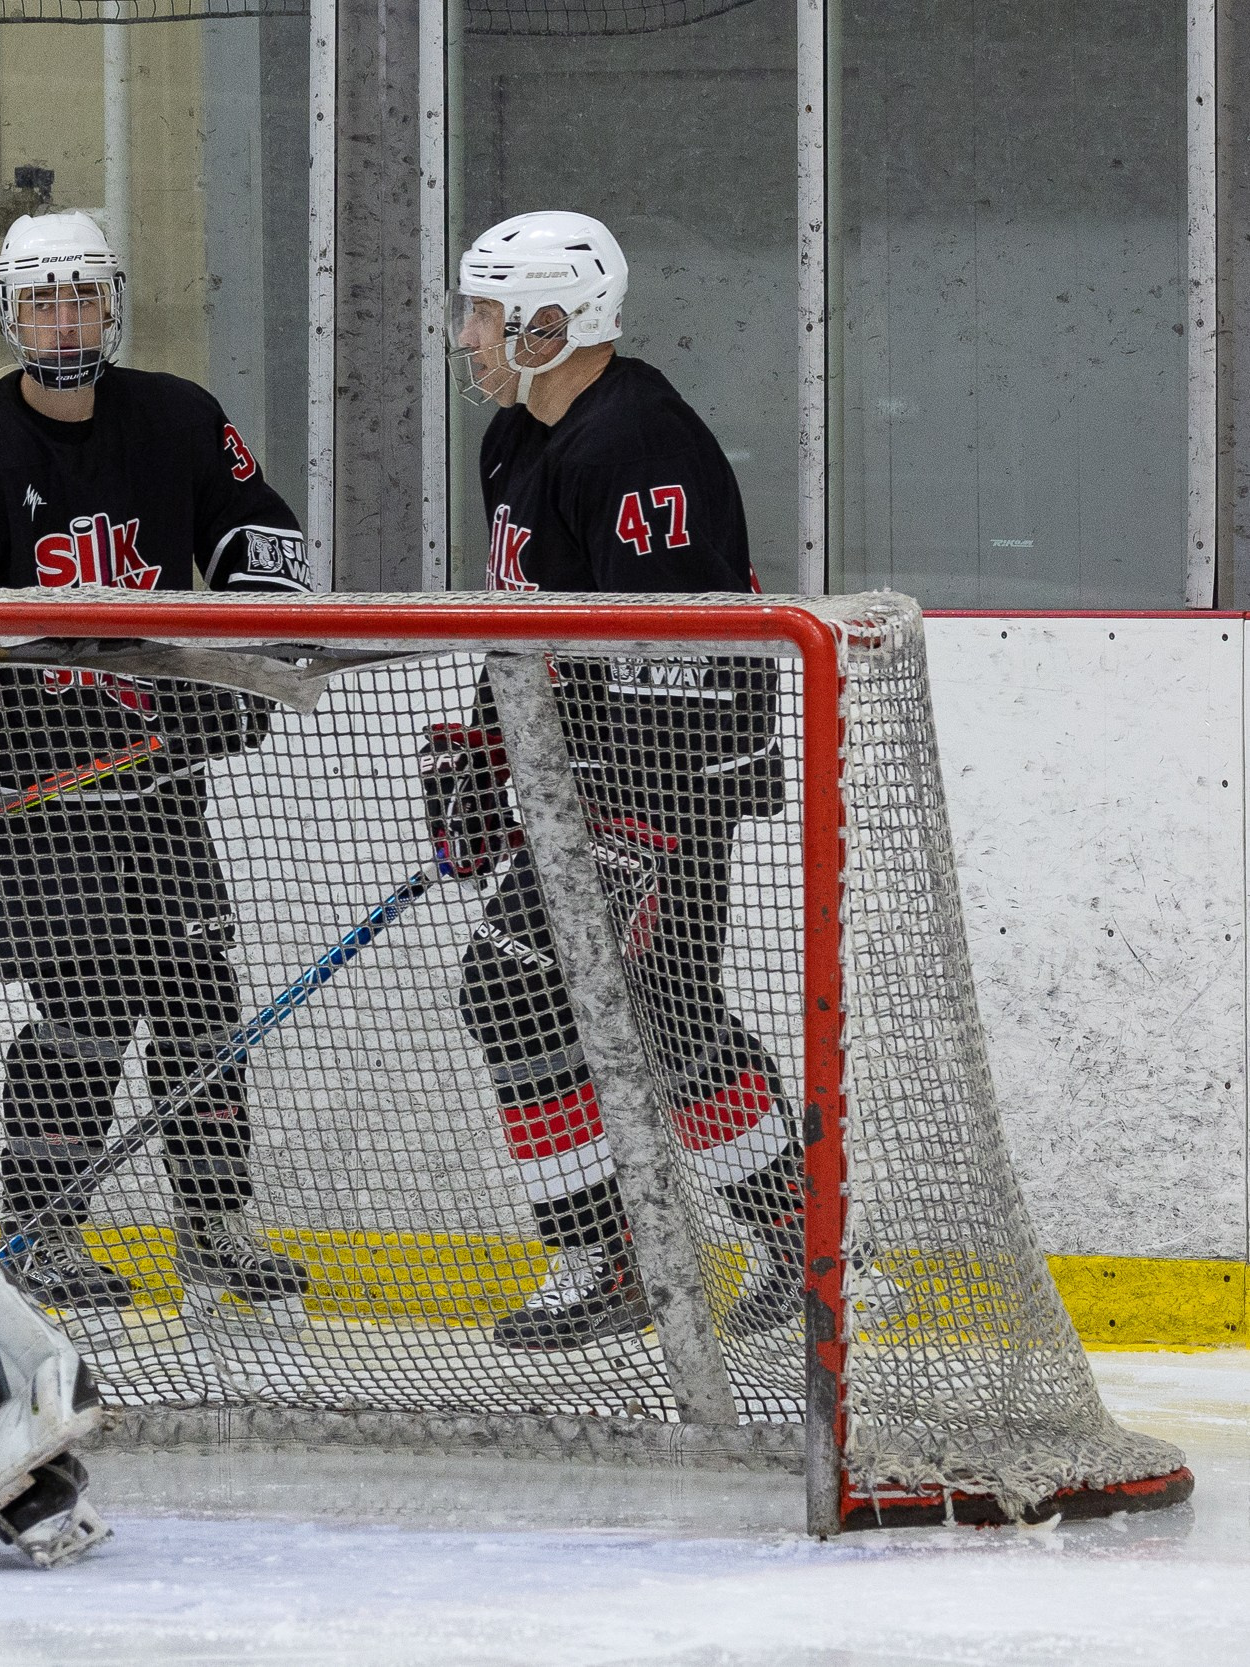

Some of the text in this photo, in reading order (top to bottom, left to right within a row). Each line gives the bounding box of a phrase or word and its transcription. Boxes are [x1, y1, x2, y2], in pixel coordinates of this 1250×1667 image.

[41, 254, 83, 264] BAUER
[525, 271, 569, 279] BAUER
[615, 484, 691, 556] 47
